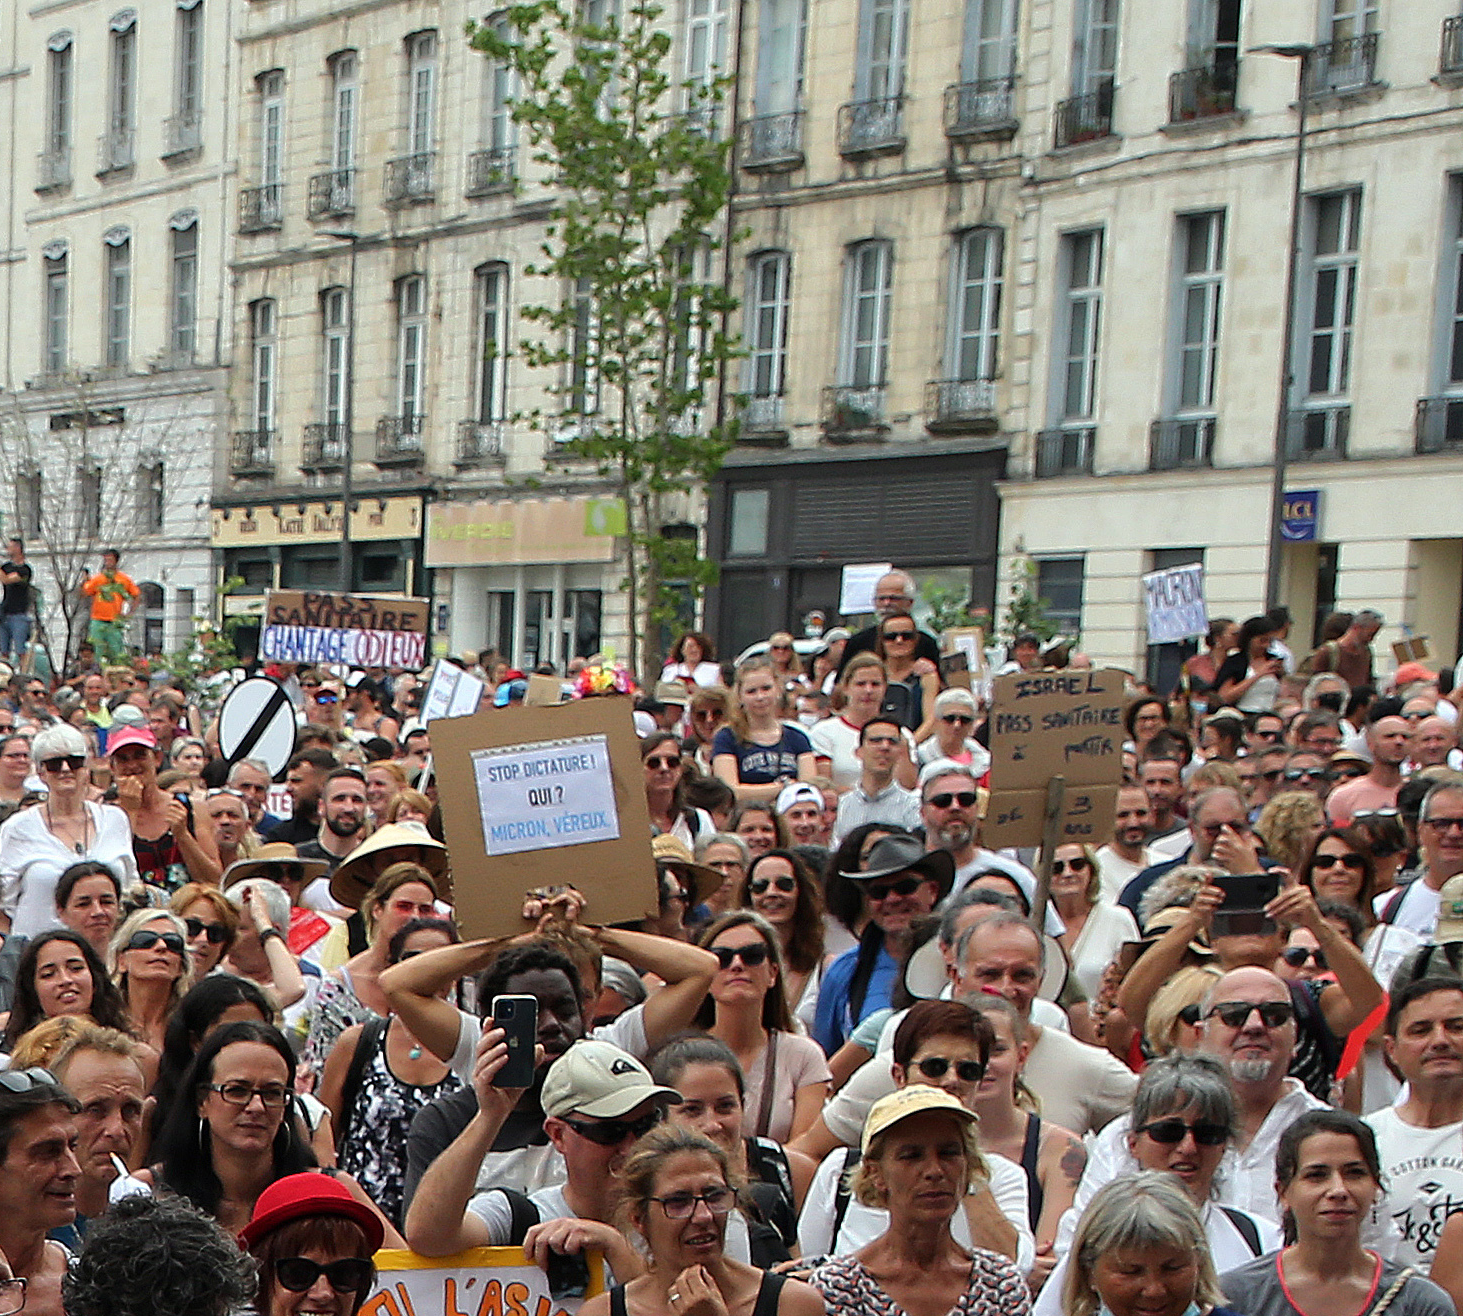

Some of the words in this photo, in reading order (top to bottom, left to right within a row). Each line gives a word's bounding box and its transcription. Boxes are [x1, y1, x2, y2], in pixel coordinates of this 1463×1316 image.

[263, 625, 349, 664] CHANTAGE
[354, 628, 426, 668] ODIEUX
[1015, 672, 1106, 699] ISRAEL
[488, 763, 521, 783] STOP
[528, 786, 552, 807] QUI
